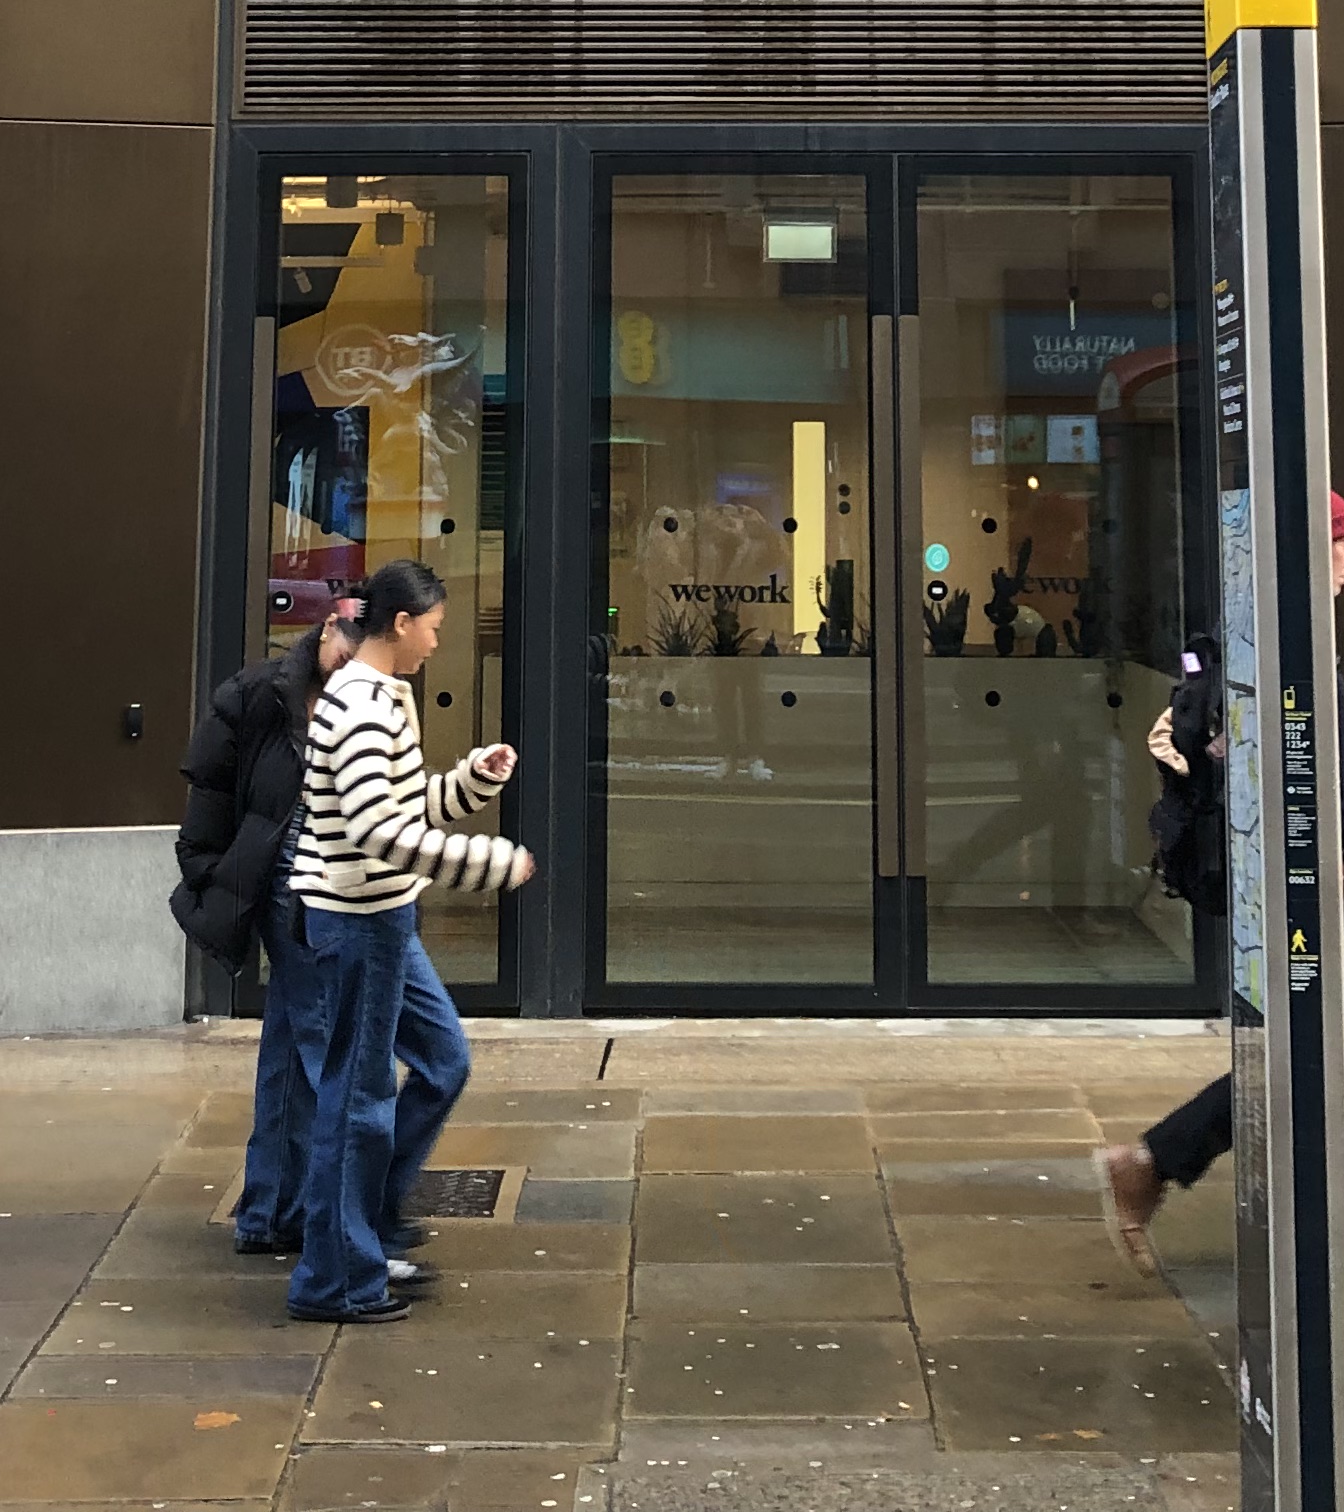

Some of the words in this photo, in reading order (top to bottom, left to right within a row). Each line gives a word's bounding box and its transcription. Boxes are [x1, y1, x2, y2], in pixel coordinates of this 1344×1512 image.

[668, 573, 792, 604] wework
[1284, 722, 1306, 731] 0343
[1285, 731, 1301, 740] 222
[1288, 875, 1316, 884] 00632
